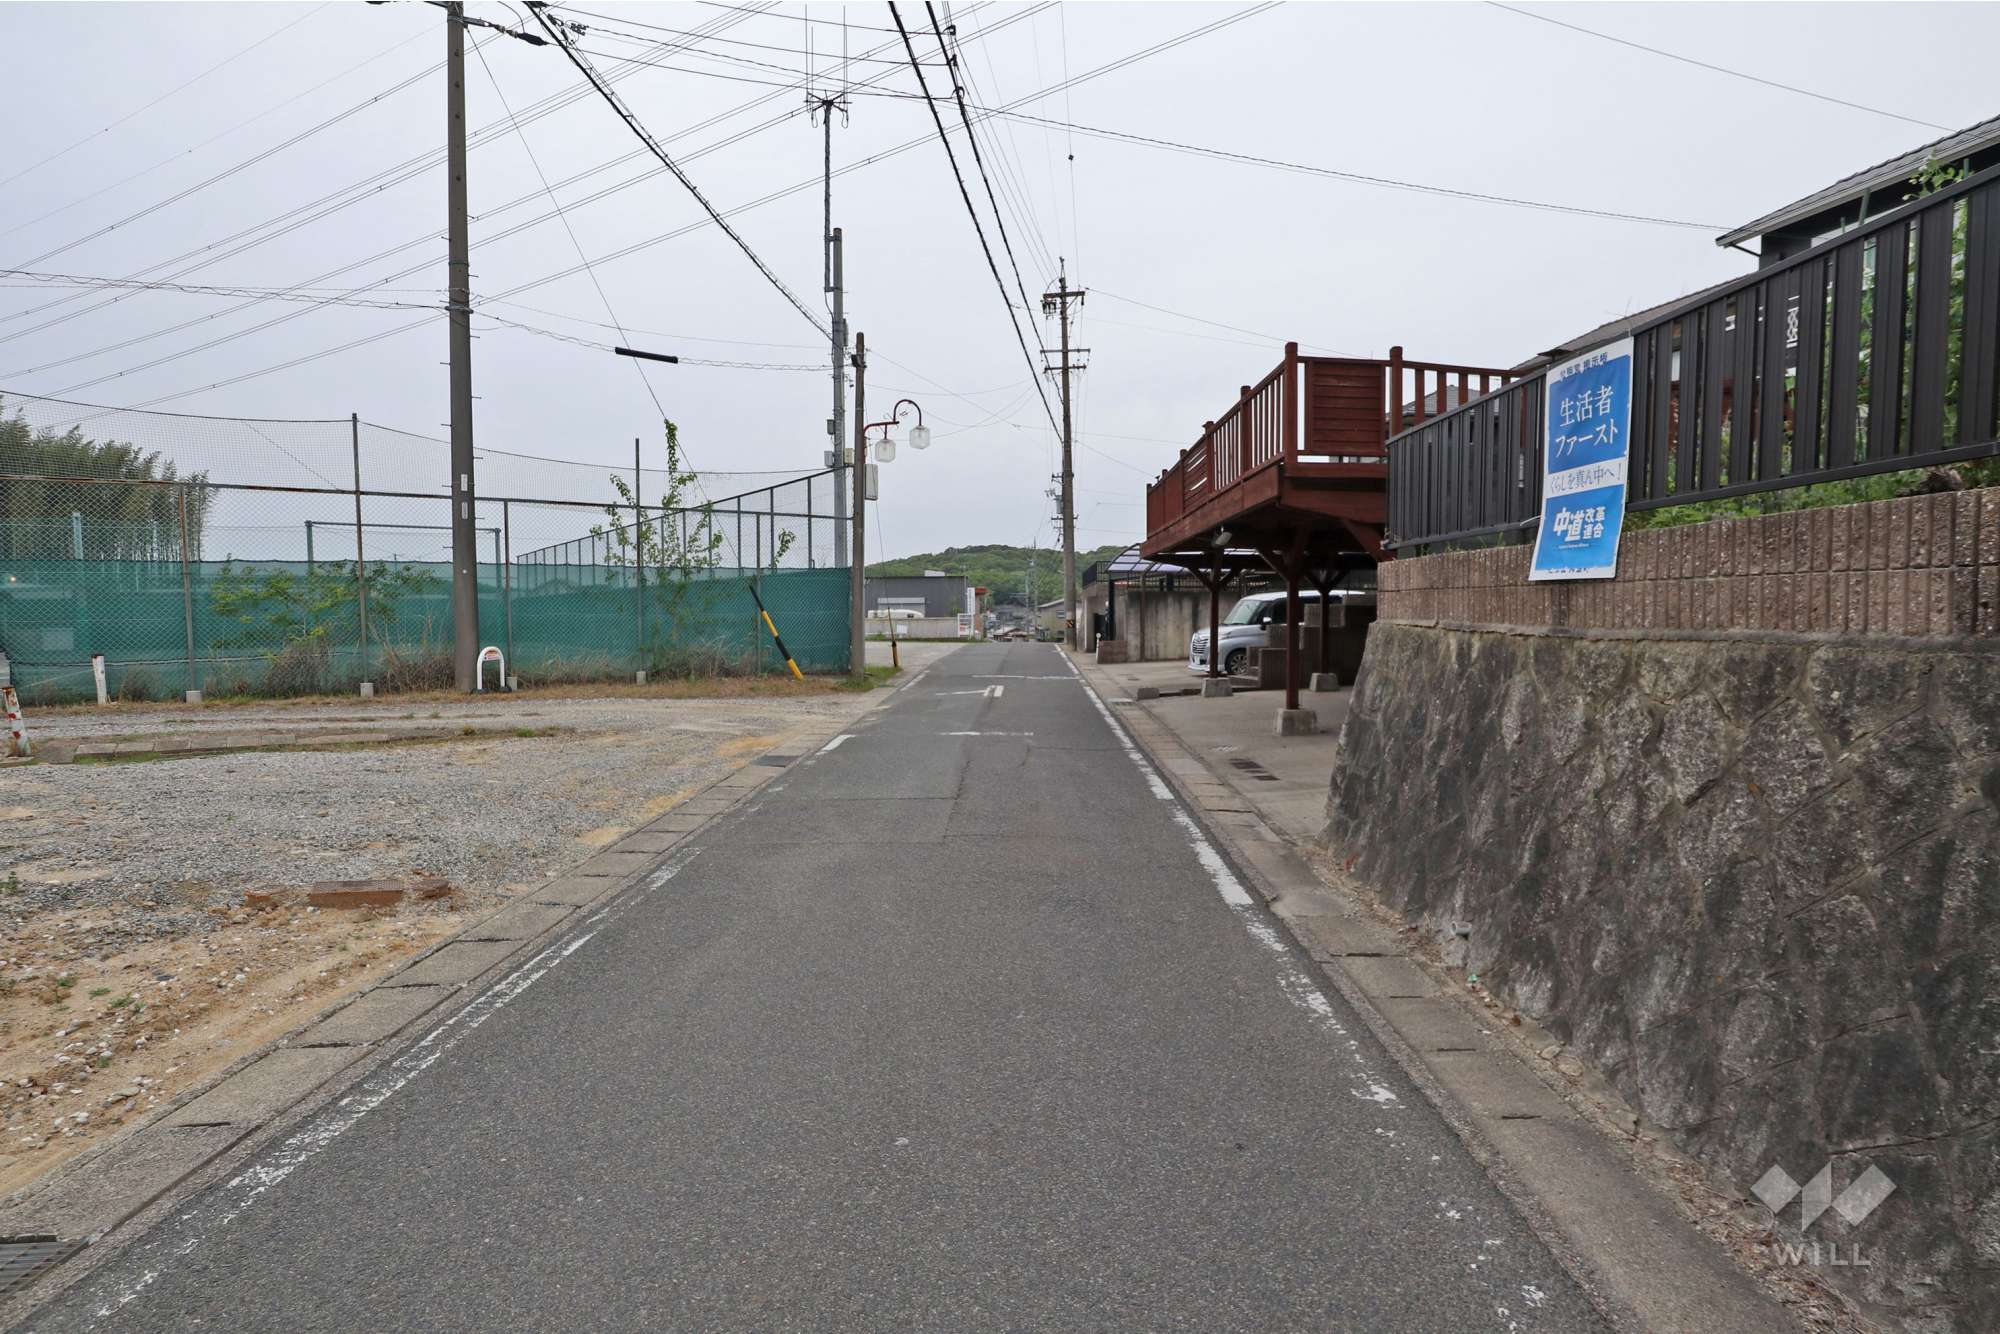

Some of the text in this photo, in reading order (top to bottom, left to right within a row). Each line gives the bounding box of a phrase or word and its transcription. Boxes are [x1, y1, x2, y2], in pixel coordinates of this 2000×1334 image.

[1560, 385, 1614, 427] 生活者
[1555, 418, 1618, 458] ファースト
